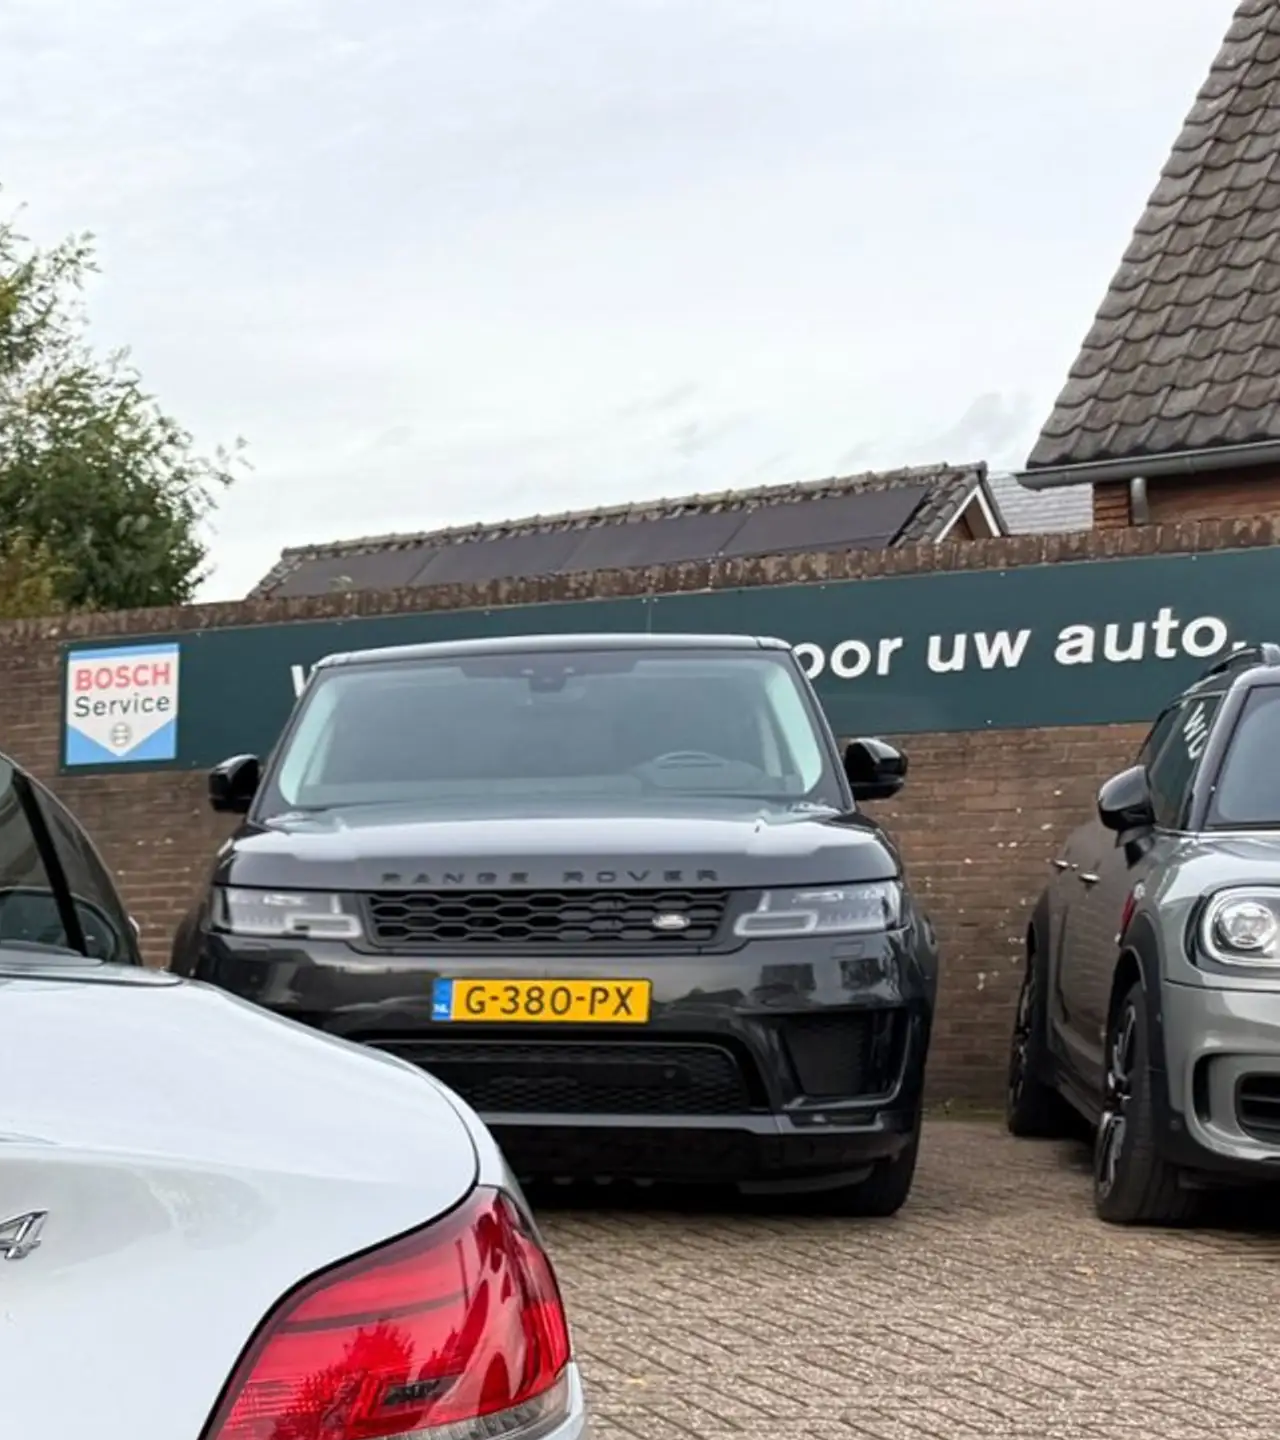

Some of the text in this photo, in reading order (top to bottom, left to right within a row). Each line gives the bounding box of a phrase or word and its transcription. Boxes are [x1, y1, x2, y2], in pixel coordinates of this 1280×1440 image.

[791, 606, 1247, 681] oor uw auto.
[74, 663, 171, 693] BOSCH
[73, 692, 171, 718] Service
[381, 869, 719, 885] RANGE ROVER
[464, 985, 634, 1016] G-380-PX
